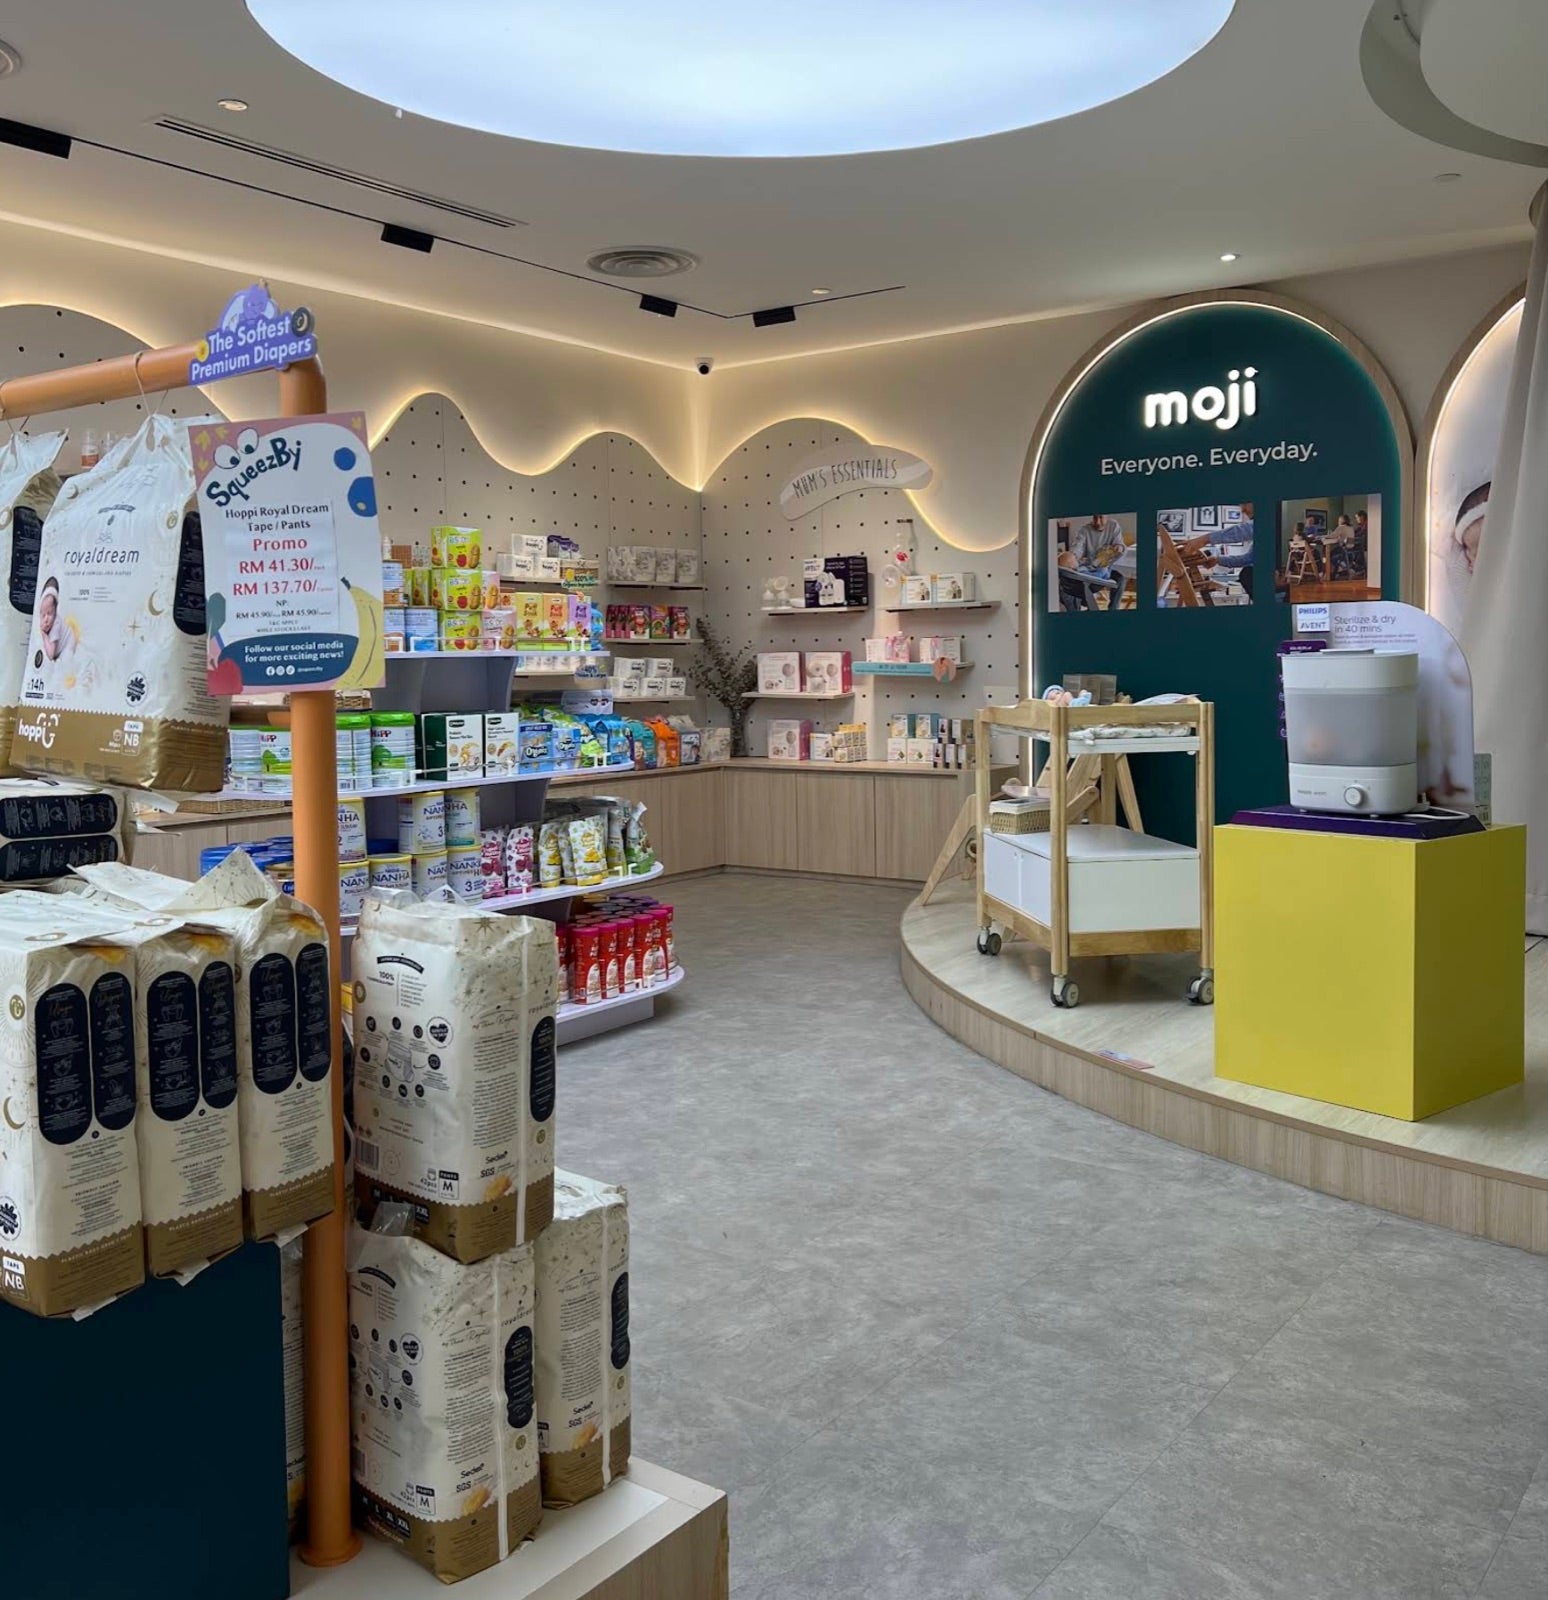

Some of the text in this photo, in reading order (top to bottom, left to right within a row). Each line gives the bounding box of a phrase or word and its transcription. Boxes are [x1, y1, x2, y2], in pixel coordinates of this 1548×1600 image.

[208, 316, 290, 354] The Softest
[192, 338, 312, 381] Premium Diapers
[1143, 366, 1258, 431] moji
[1101, 441, 1319, 476] Everyone. Everyday.
[206, 437, 303, 508] SqueezBy
[791, 458, 898, 499] MUM'S ESSENTIALS
[225, 504, 330, 520] Hoppi Royal Dream
[248, 522, 274, 533] Tape
[281, 519, 311, 530] Pants
[253, 538, 308, 552] Promo
[64, 546, 140, 568] royaldream
[239, 560, 264, 574] RM
[268, 558, 314, 572] 41.30/
[232, 579, 318, 596] RM 137.70/
[236, 612, 249, 620] RM
[1298, 607, 1328, 615] PHILIPS
[1334, 615, 1396, 625] Sterilize & dry
[1334, 625, 1383, 634] in 40 mins
[244, 645, 274, 654] Follow
[290, 642, 316, 651] social
[316, 640, 344, 650] media
[244, 654, 258, 663] for
[283, 652, 319, 662] exciting
[319, 650, 344, 660] news!
[124, 732, 140, 747] NB
[341, 878, 365, 887] NAN
[372, 874, 397, 882] NAN
[465, 881, 473, 892] 3
[379, 971, 395, 981] 100%
[480, 1167, 495, 1178] SGS
[442, 1181, 453, 1192] M
[4, 1271, 24, 1290] NB
[456, 1481, 471, 1492] SGS
[419, 1496, 430, 1508] M
